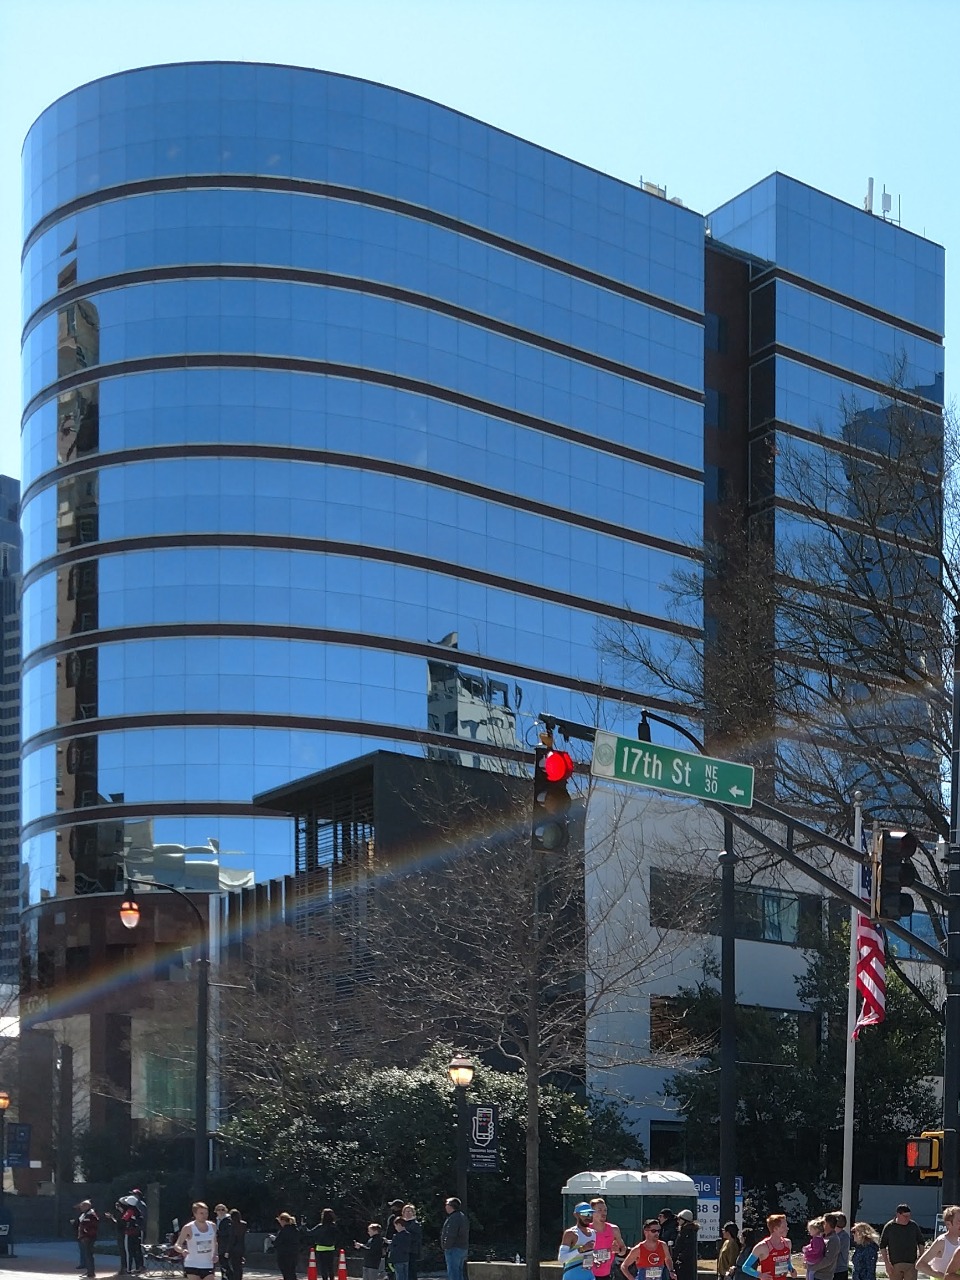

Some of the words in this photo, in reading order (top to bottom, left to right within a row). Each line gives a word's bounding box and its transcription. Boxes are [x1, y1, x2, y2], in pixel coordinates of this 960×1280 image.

[622, 746, 663, 780] 17th
[671, 758, 692, 787] St
[705, 764, 719, 780] NE
[704, 780, 718, 794] 30
[694, 1181, 711, 1192] ale
